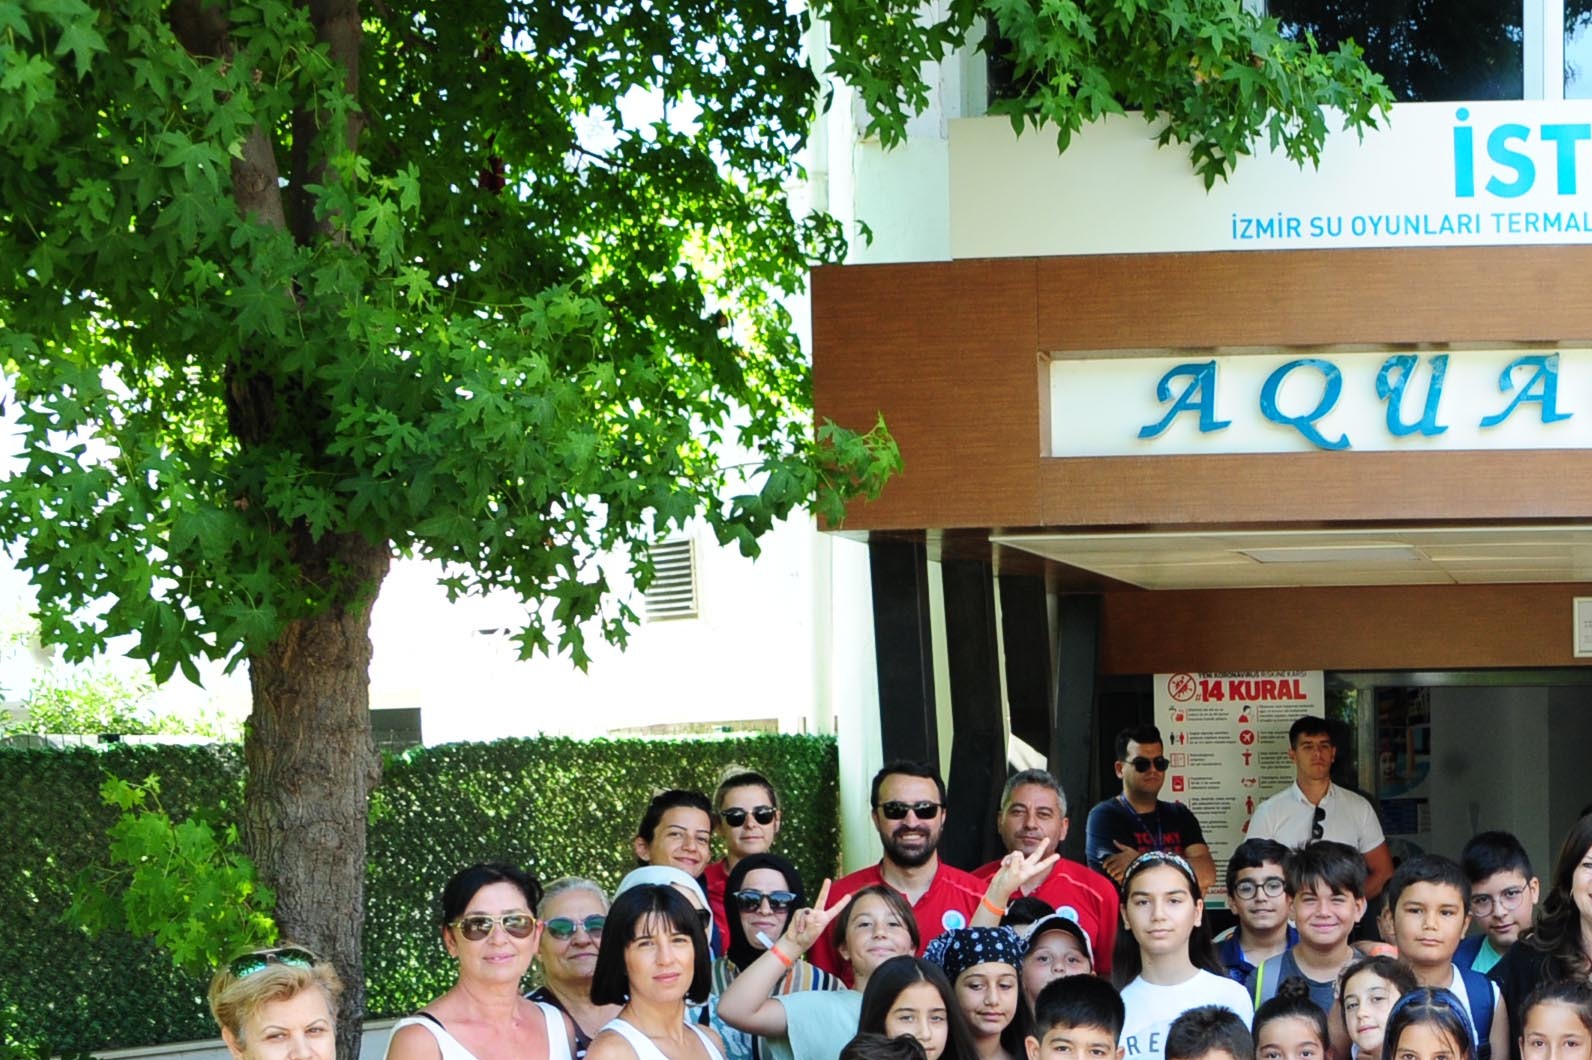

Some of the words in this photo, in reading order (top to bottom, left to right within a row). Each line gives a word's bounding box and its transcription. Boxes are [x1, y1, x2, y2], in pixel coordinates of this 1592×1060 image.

[1231, 212, 1301, 240] İZMİR
[1309, 211, 1343, 238] SU
[1350, 210, 1480, 237] OYUNLARI
[1229, 679, 1308, 701] KURAL
[1126, 1032, 1161, 1056] RE
